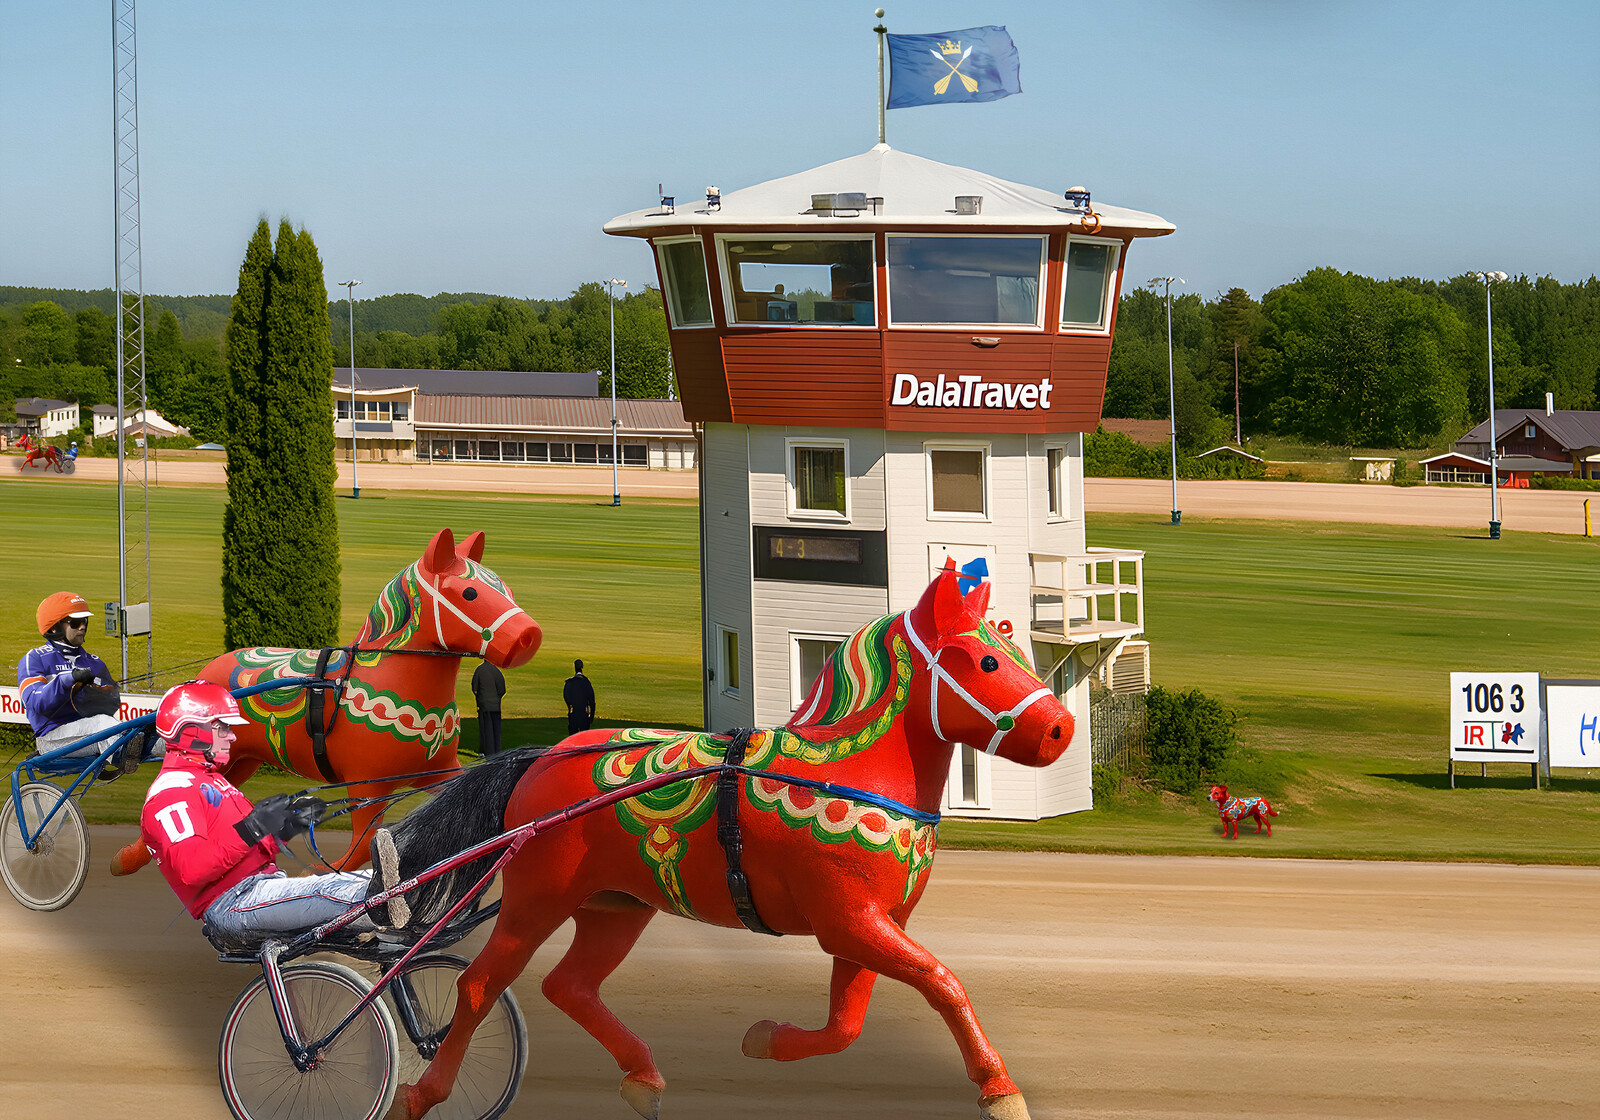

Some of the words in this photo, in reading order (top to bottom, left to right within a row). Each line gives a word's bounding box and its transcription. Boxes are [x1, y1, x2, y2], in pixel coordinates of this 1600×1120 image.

[891, 373, 1053, 409] DalaTravet
[1462, 683, 1504, 713] 106
[1510, 683, 1525, 713] 3
